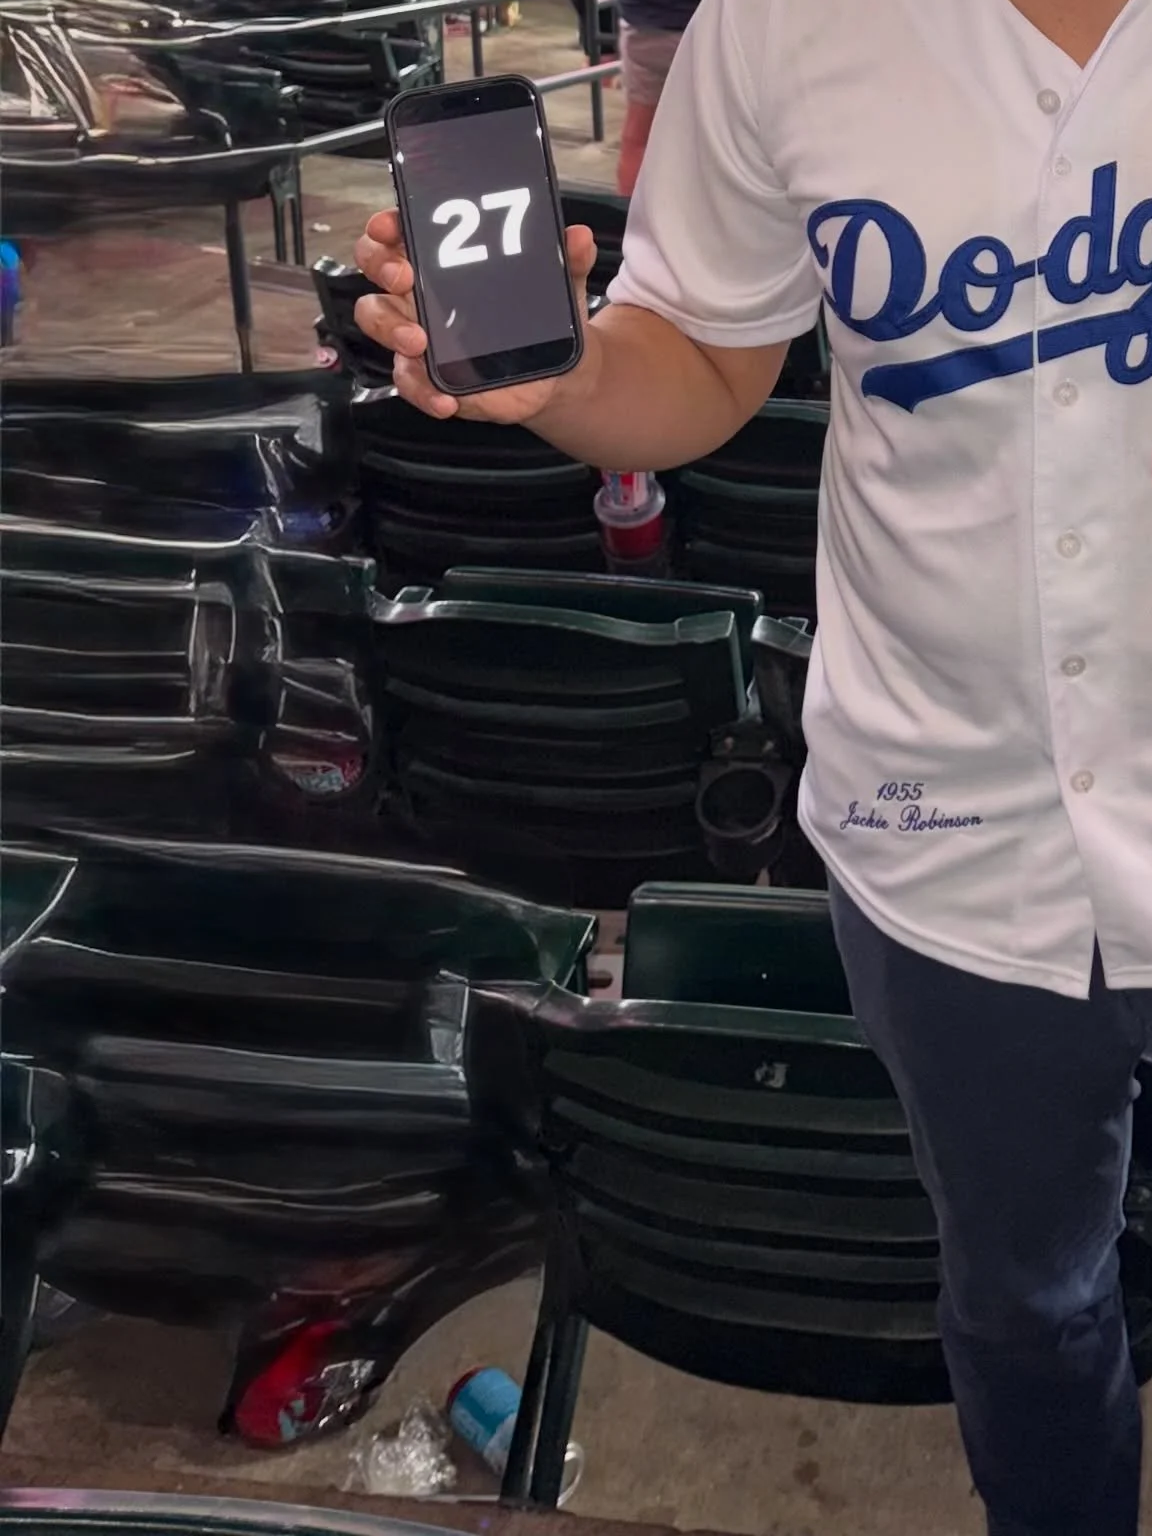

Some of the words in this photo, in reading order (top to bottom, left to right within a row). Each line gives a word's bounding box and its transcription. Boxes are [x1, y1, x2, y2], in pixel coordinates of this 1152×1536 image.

[431, 187, 531, 268] 27
[876, 782, 924, 802] 1955
[839, 800, 890, 831] Jackie
[897, 804, 984, 832] Robinson
